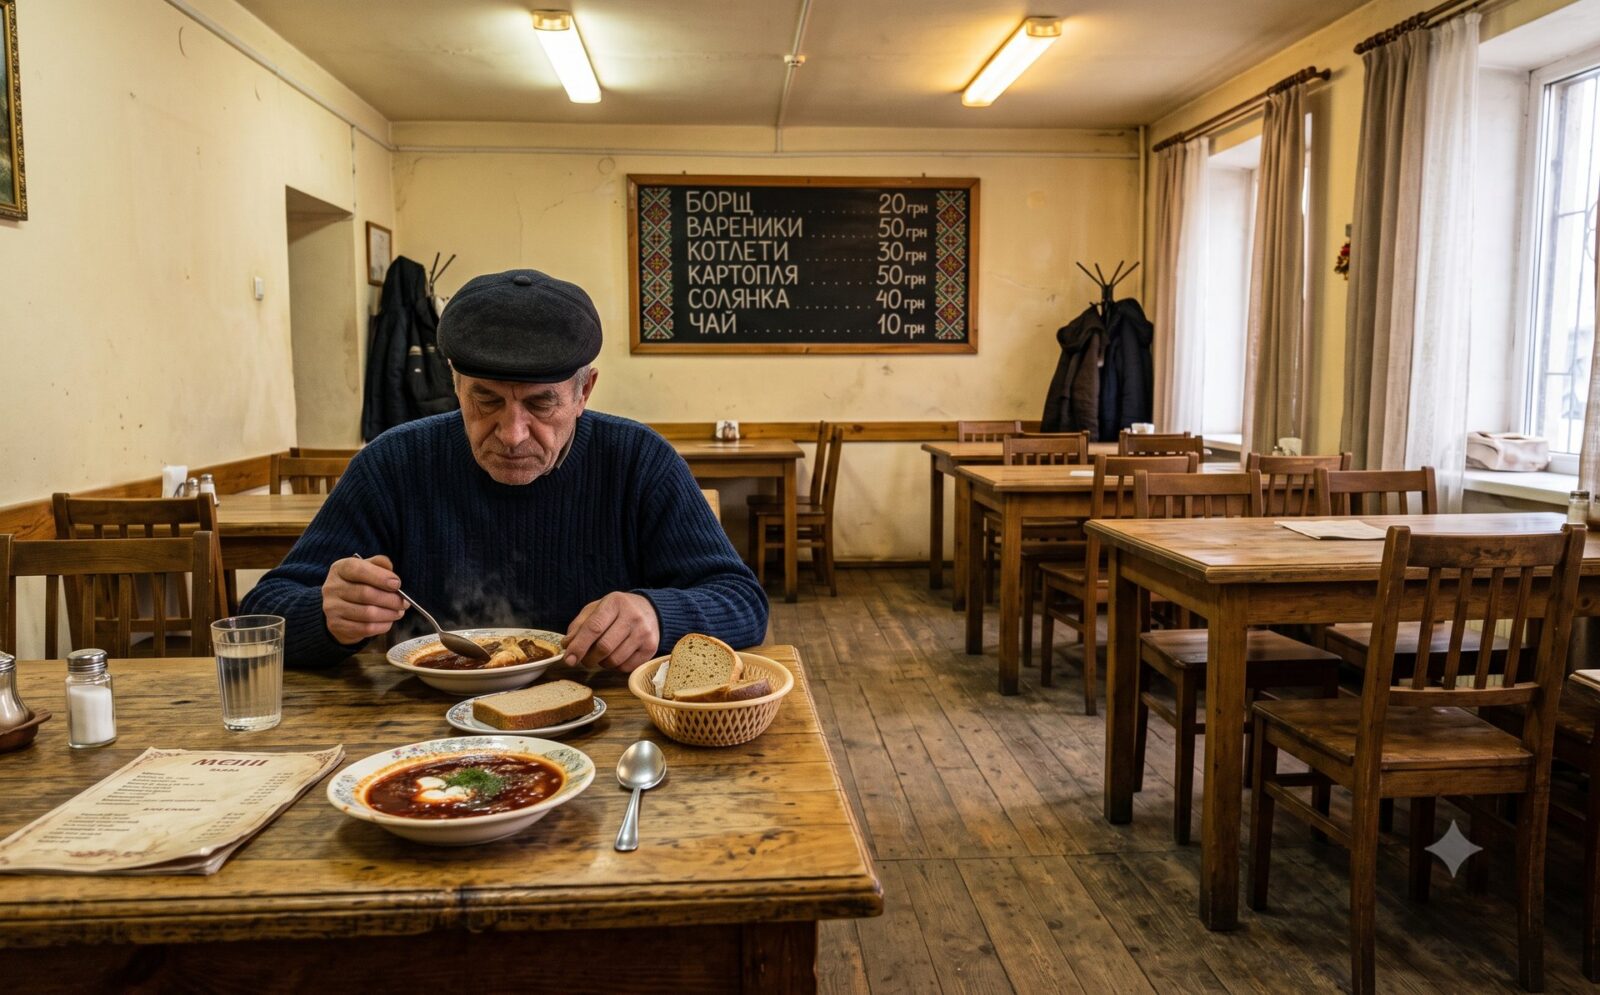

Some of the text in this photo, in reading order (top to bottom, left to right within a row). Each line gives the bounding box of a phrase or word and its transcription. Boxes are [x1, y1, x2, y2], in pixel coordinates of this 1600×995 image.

[686, 191, 754, 216] БОРЩ
[879, 193, 906, 214] 20
[687, 216, 803, 238] ВАРЕНИКИ
[878, 217, 905, 238] 50
[687, 240, 789, 262] КОТЛЕТИ
[877, 241, 904, 262] 30
[688, 264, 799, 285] КАРТОПЛЯ
[876, 265, 903, 285] 50
[688, 288, 790, 309] СОЛЯНКА
[875, 288, 902, 310] 40
[689, 310, 737, 334] ЧАЙ
[877, 313, 901, 335] 10
